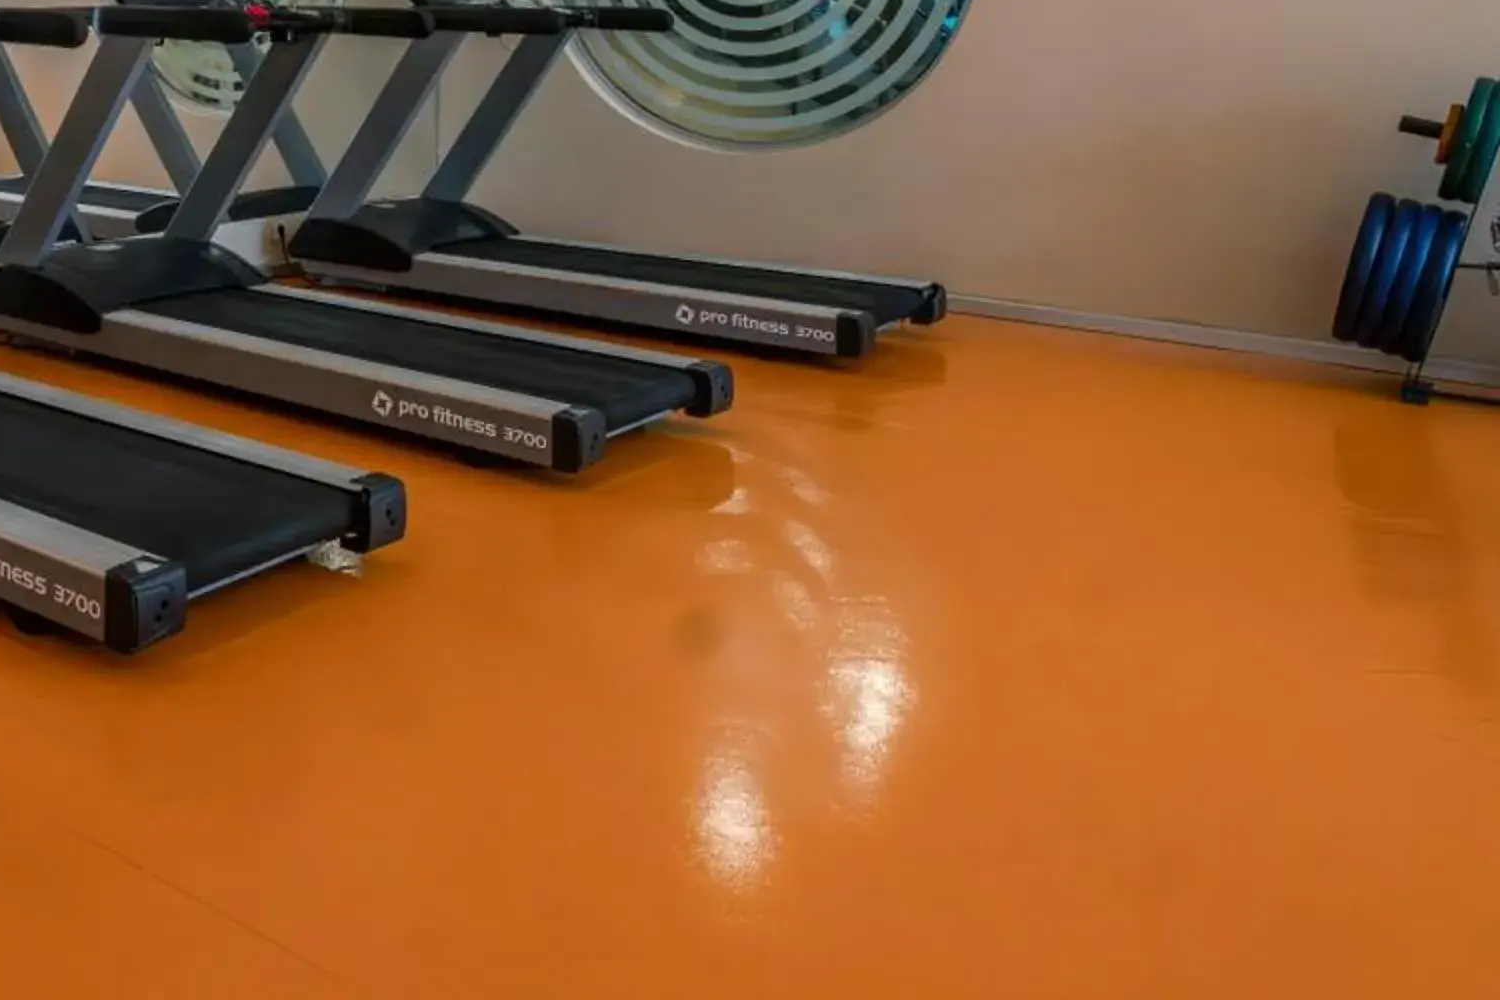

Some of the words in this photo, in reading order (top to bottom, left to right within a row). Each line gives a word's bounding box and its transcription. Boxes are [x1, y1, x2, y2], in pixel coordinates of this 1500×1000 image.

[700, 310, 728, 325] pro
[731, 313, 789, 335] fitness
[795, 325, 835, 342] 3700
[399, 400, 429, 419] pro
[432, 406, 497, 437] fitness
[503, 427, 547, 449] 3700
[53, 583, 101, 619] 3700
